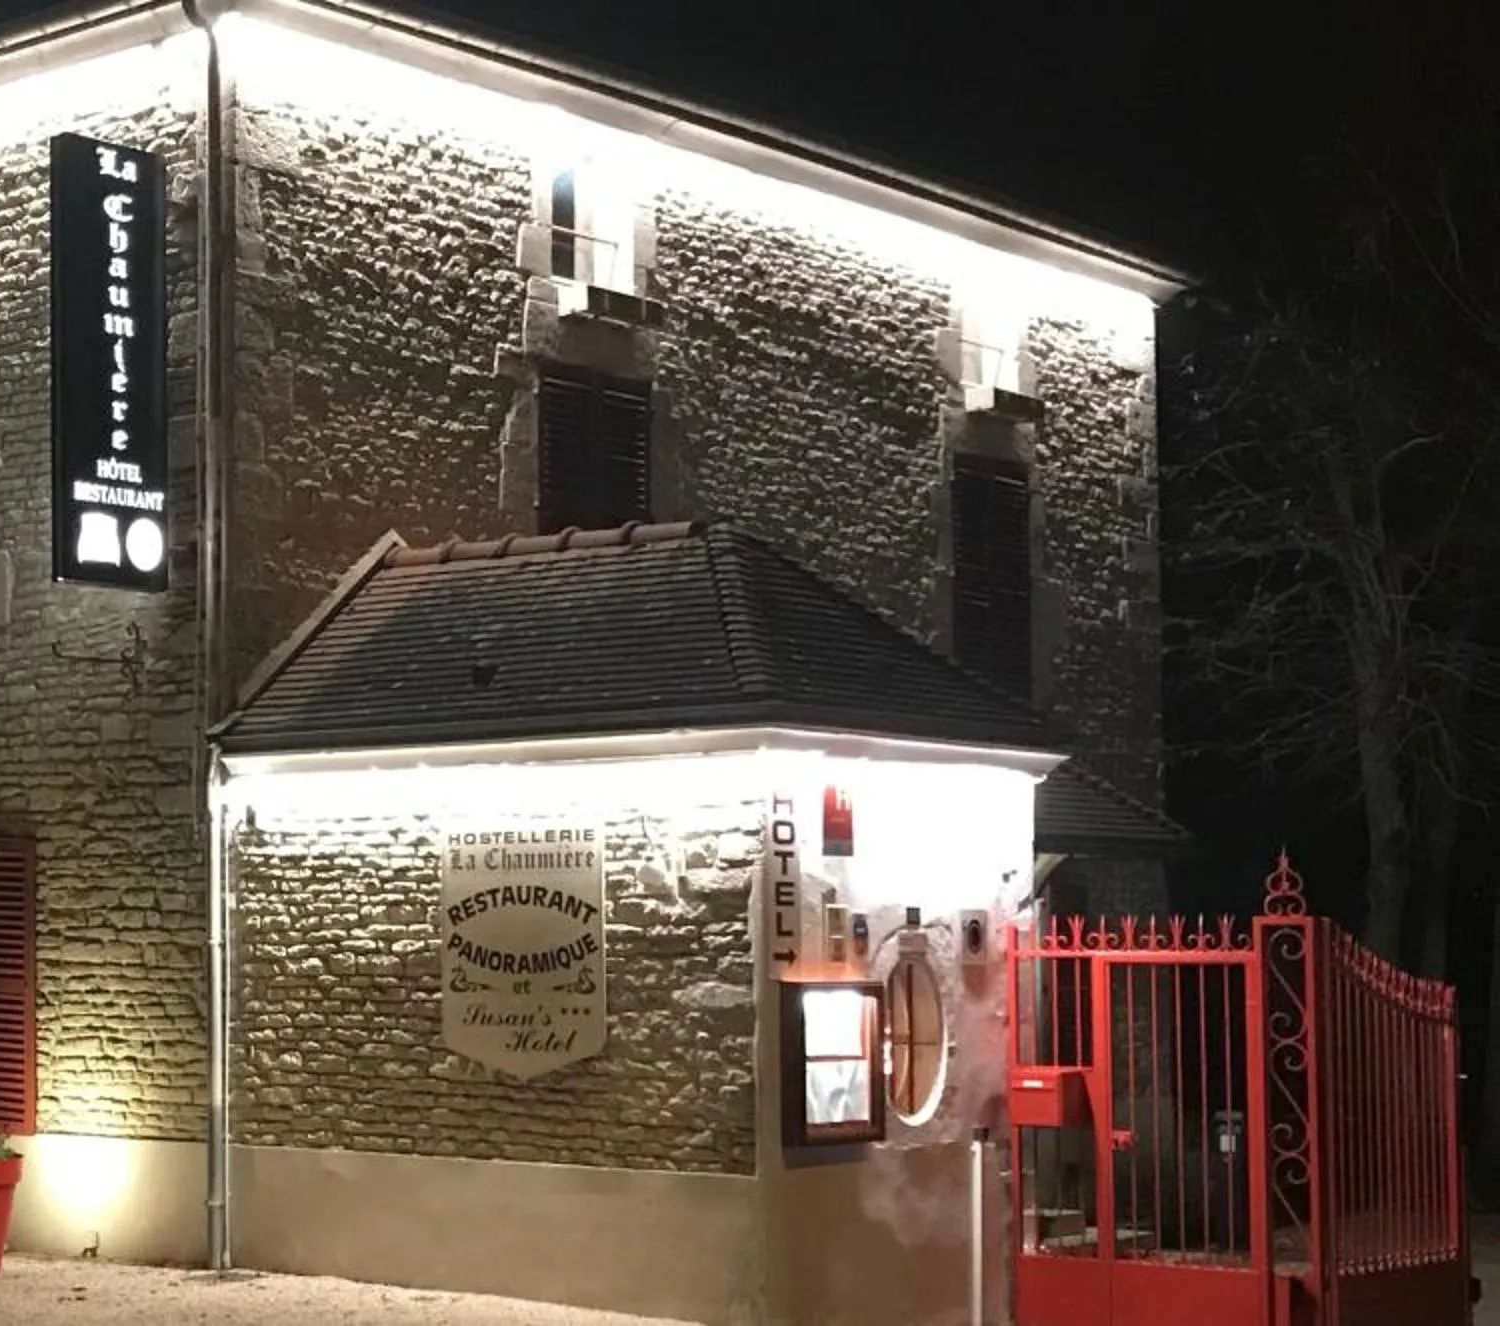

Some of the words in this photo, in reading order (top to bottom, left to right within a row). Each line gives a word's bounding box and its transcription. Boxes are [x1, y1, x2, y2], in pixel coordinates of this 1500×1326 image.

[96, 146, 138, 183] La
[97, 456, 143, 484] HÔTEL
[73, 480, 165, 512] RESTAURANT
[448, 829, 596, 846] HOSTELLERIE
[450, 848, 476, 870] La
[772, 792, 796, 937] HOTEL
[447, 885, 598, 926] RESTAURANT
[447, 932, 599, 975] PANORAMIQUE
[513, 980, 532, 995] et
